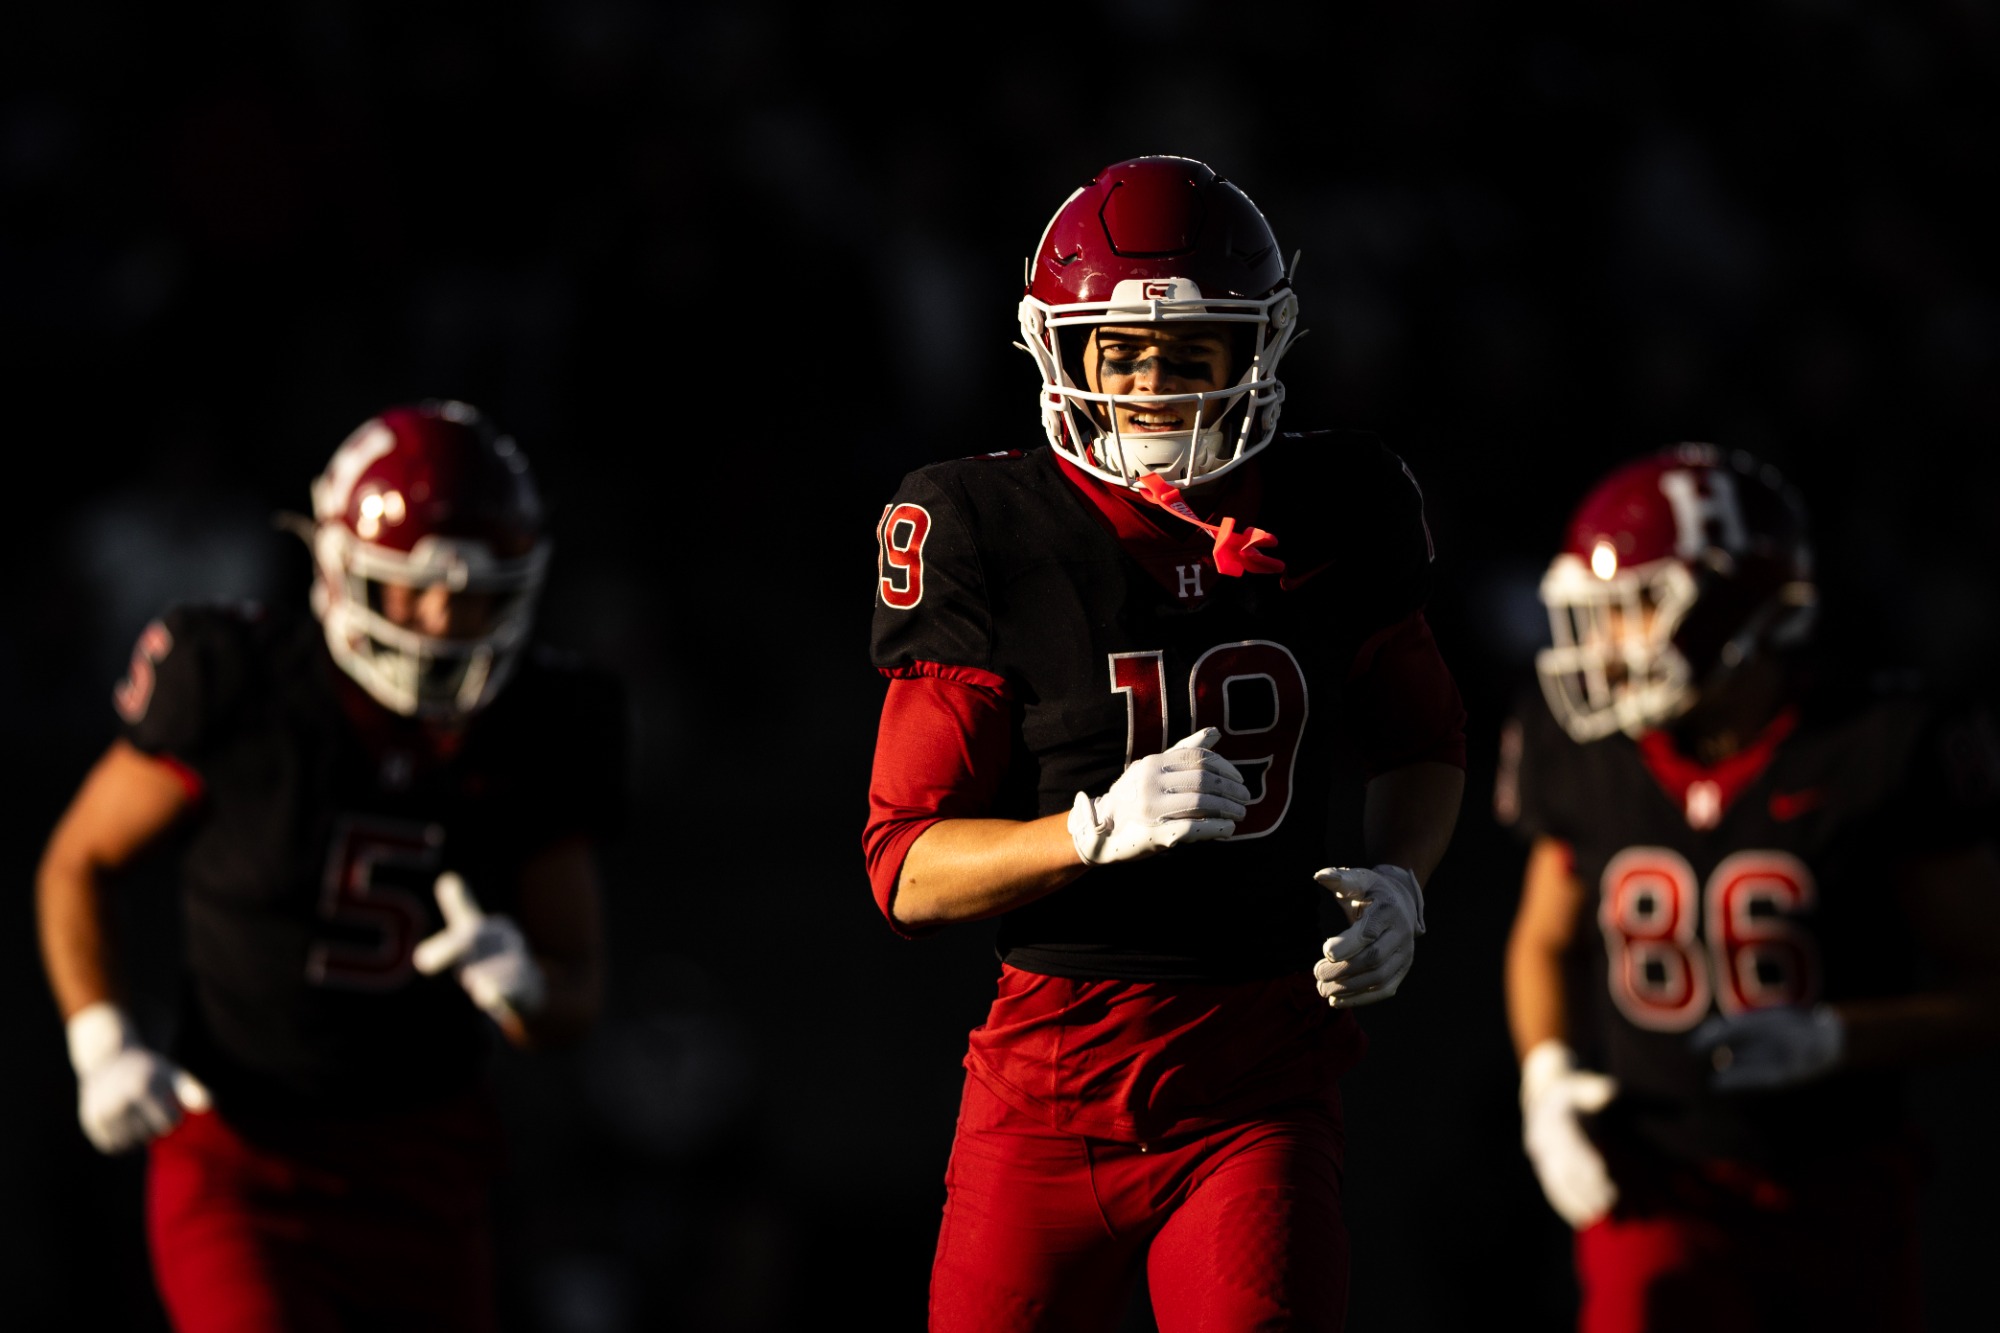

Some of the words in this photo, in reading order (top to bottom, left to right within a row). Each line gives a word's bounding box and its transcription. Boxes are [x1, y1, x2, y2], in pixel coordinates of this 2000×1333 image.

[876, 503, 931, 609] 9
[1176, 564, 1204, 598] H
[1658, 468, 1749, 560] H
[1108, 640, 1309, 841] 19
[305, 810, 447, 993] 5
[1599, 846, 1824, 1034] 86
